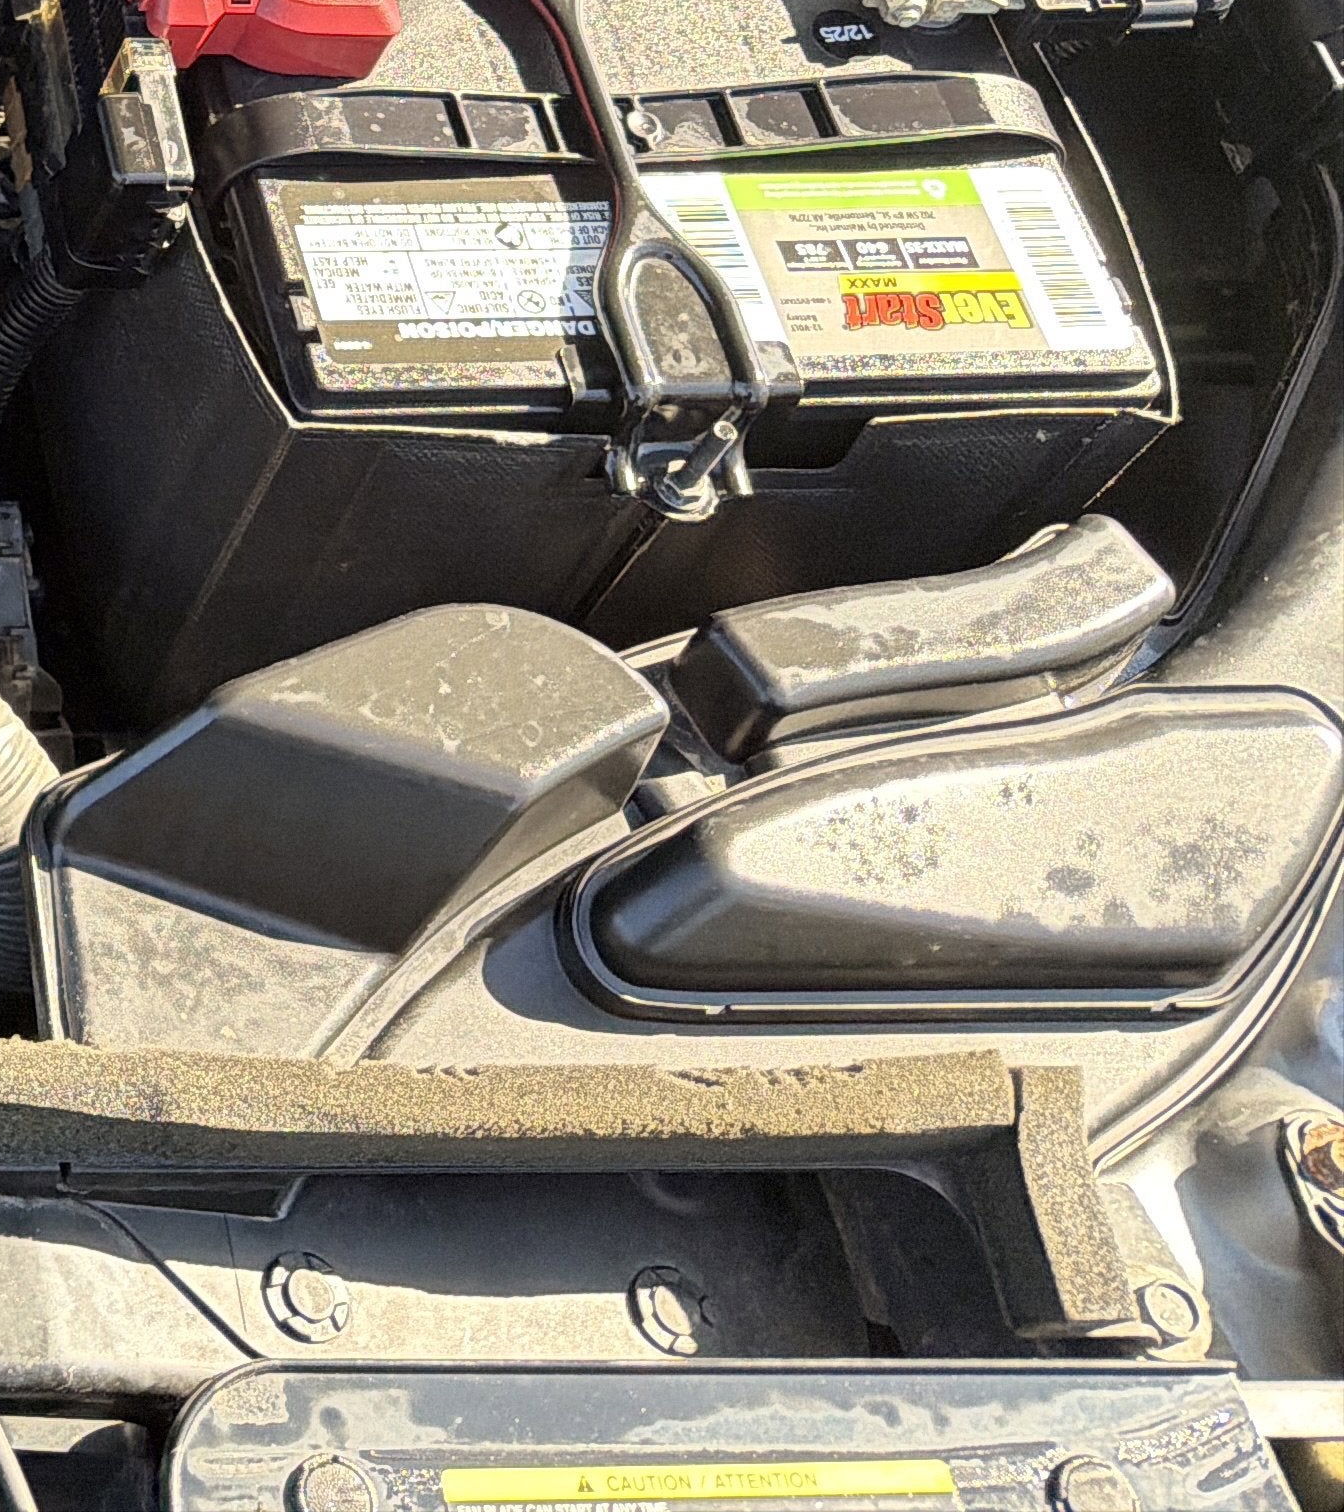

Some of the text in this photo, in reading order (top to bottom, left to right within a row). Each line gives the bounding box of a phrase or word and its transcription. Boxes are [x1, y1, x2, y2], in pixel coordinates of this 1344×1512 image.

[828, 223, 866, 232] Walmart
[312, 257, 368, 266] HELP FAST
[313, 268, 360, 278] MEDICAL
[316, 279, 335, 288] GET
[344, 283, 413, 292] WITH WATER
[845, 277, 897, 289] MAXX
[344, 294, 417, 304] IMMEDIATELY
[479, 291, 504, 300] ACID
[356, 305, 420, 315] FLUSH EYES
[457, 304, 509, 313] SULFURIC
[841, 291, 1033, 332] EverStart
[607, 1475, 692, 1492] CAUTION
[715, 1472, 818, 1489] ATTENTION
